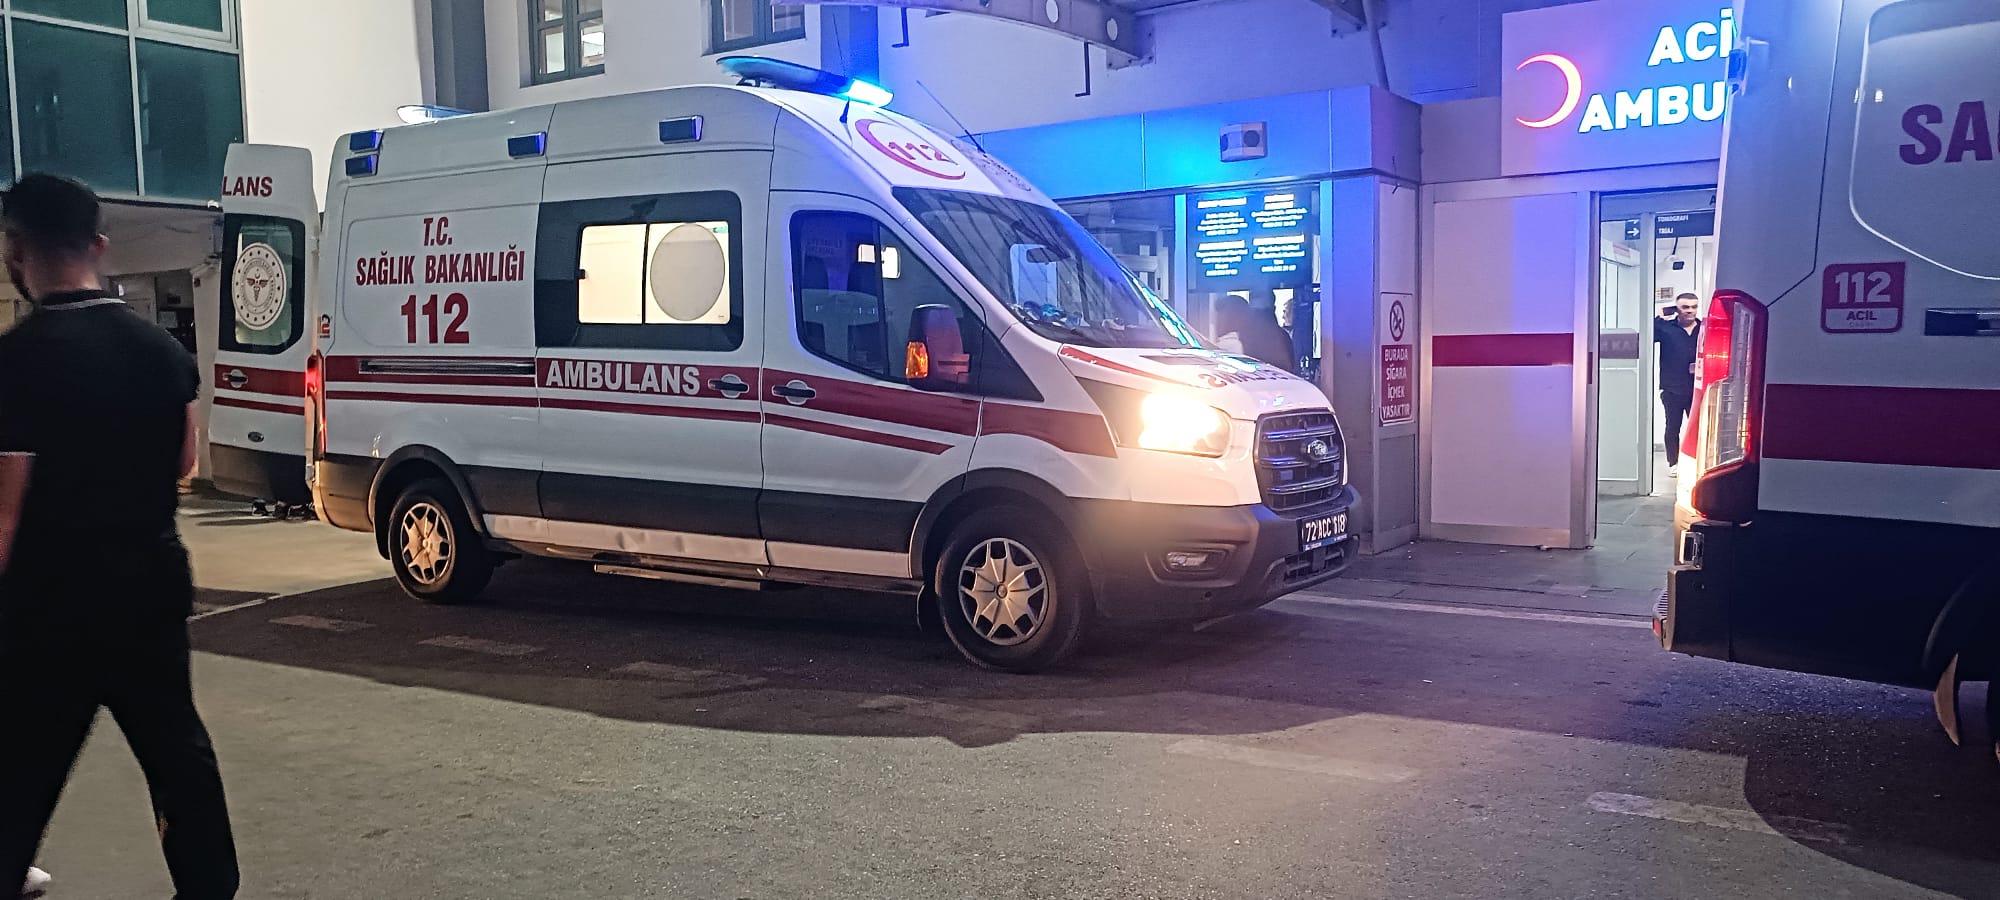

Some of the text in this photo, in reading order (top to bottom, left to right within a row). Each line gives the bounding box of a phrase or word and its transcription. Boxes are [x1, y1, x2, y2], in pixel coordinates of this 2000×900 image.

[1647, 8, 1733, 66] ACİ
[1578, 81, 1726, 133] AMBU
[1900, 101, 2000, 165] SA
[222, 176, 273, 197] LANS
[424, 216, 453, 246] T.C.
[356, 244, 525, 286] SAĞLIK BAKANLIĞI
[1835, 271, 1892, 303] 112
[400, 292, 470, 344] 112
[1384, 348, 1409, 361] BURADA
[545, 360, 701, 395] AMBULANS
[1382, 403, 1411, 419] YASAKTIR
[1305, 521, 1317, 543] 72
[1317, 517, 1332, 540] ACC
